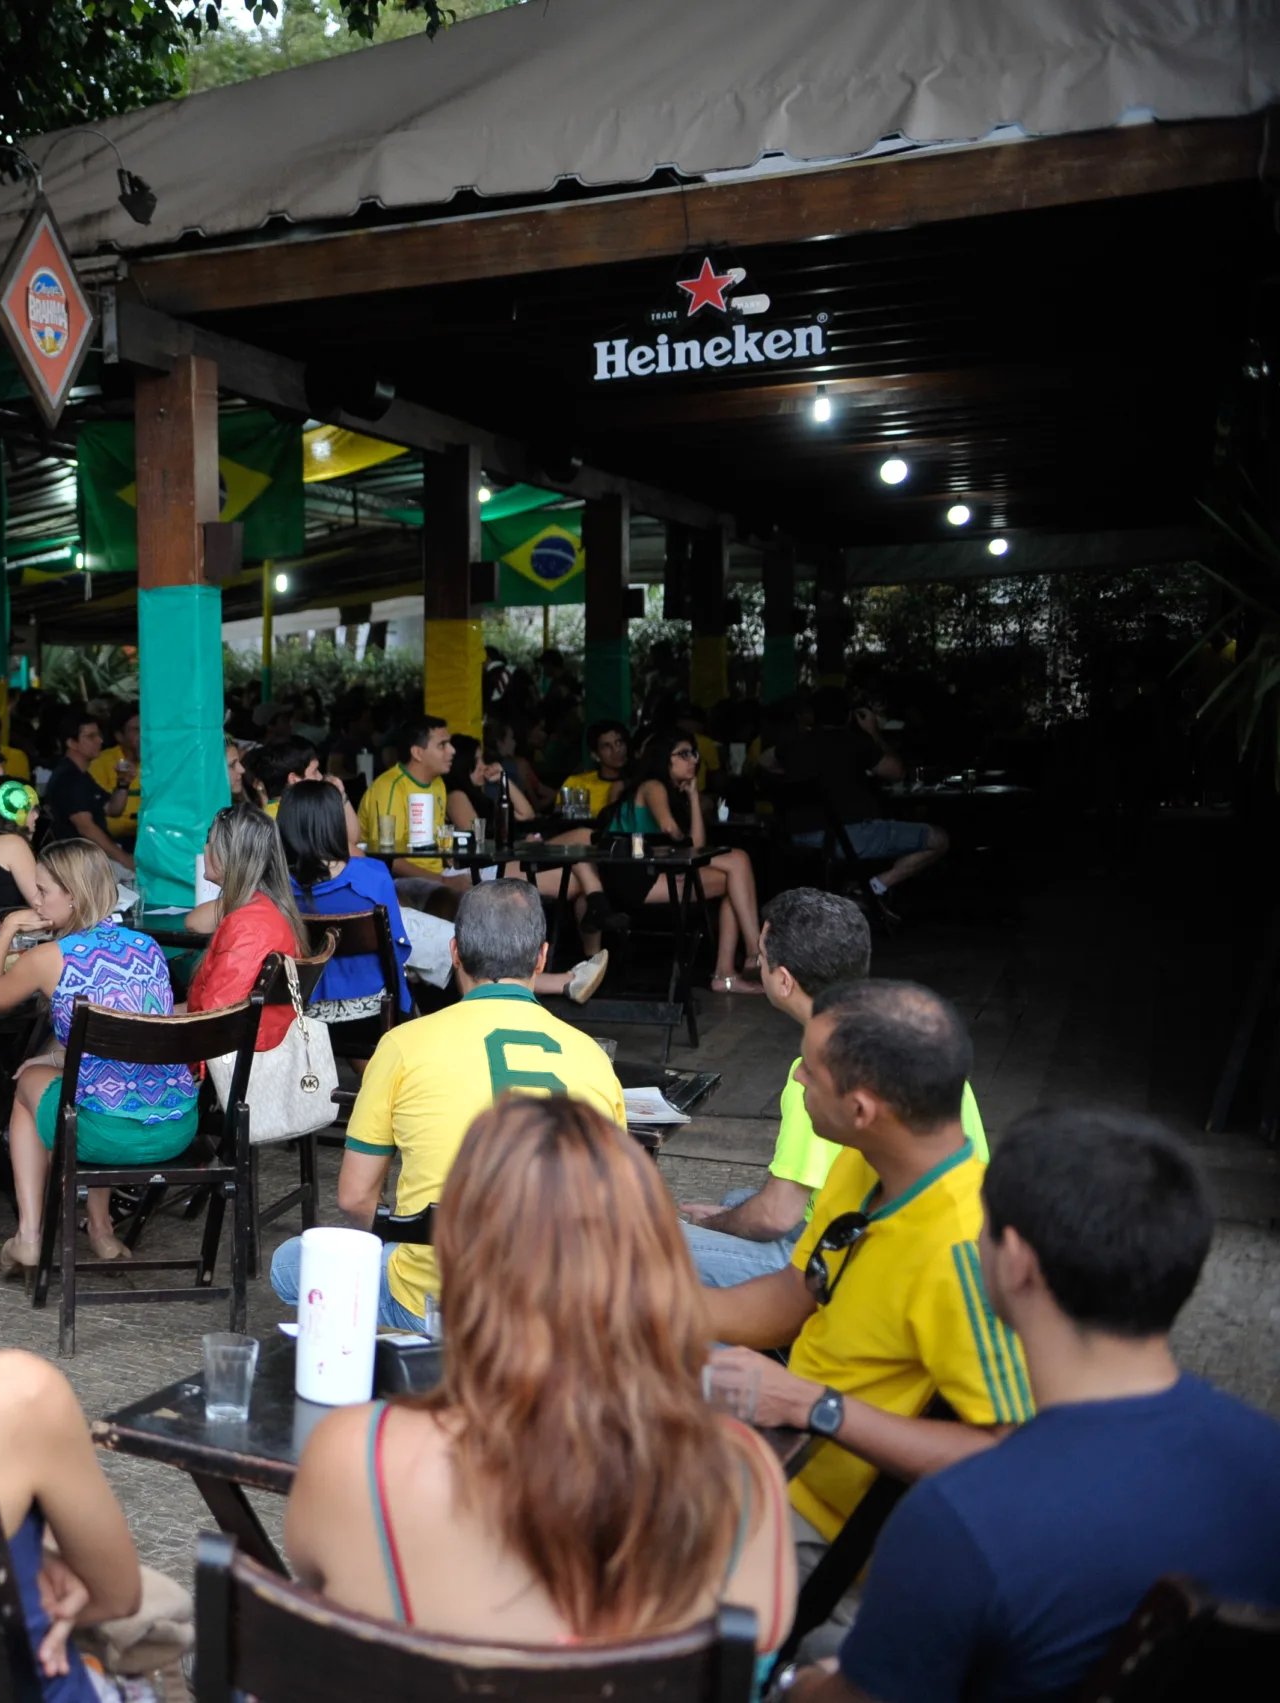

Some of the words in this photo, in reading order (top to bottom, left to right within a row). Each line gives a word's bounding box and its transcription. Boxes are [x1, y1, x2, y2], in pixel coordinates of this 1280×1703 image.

[28, 293, 68, 329] BRAHMA
[650, 310, 678, 321] TRADE
[593, 324, 827, 381] Heineken
[484, 1027, 568, 1103] 6
[302, 1079, 317, 1088] MK
